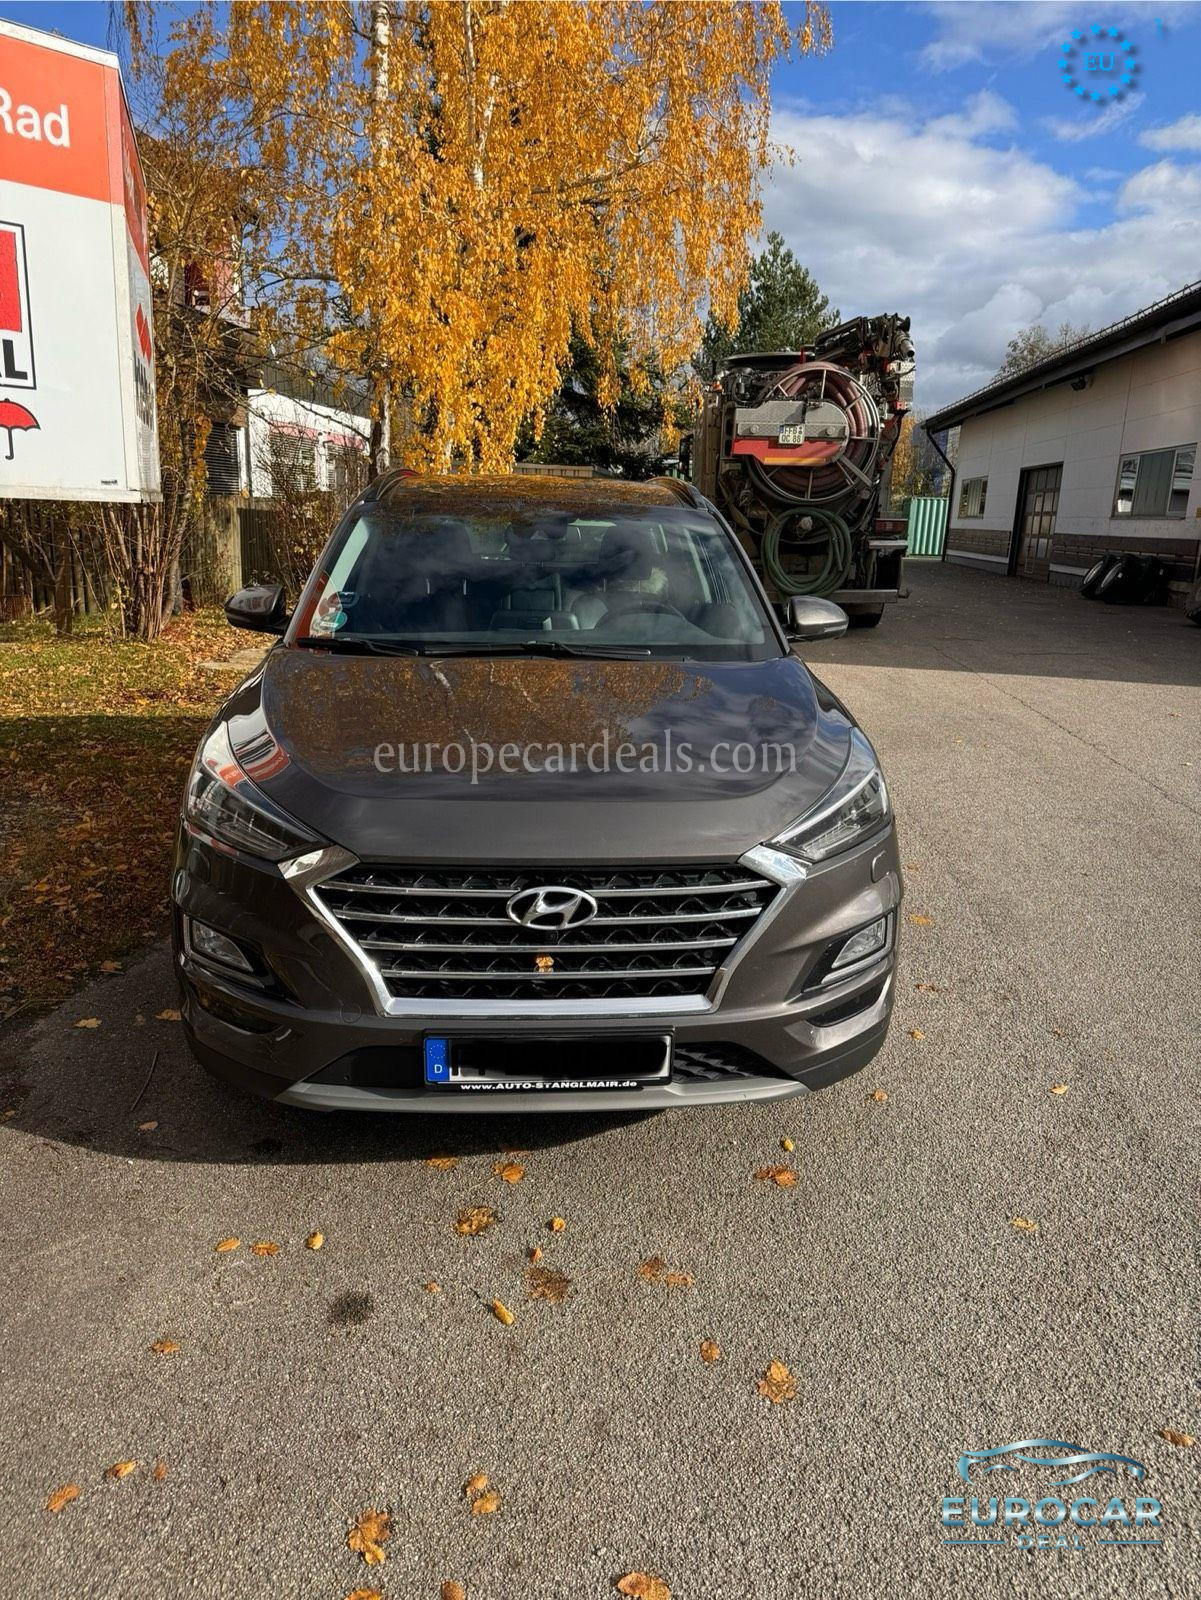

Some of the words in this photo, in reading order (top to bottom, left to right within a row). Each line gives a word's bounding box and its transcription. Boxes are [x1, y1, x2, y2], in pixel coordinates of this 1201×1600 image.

[0, 338, 28, 380] L
[434, 1064, 443, 1073] D
[460, 1080, 638, 1090] www.AUTO-STANGLMAIR.de
